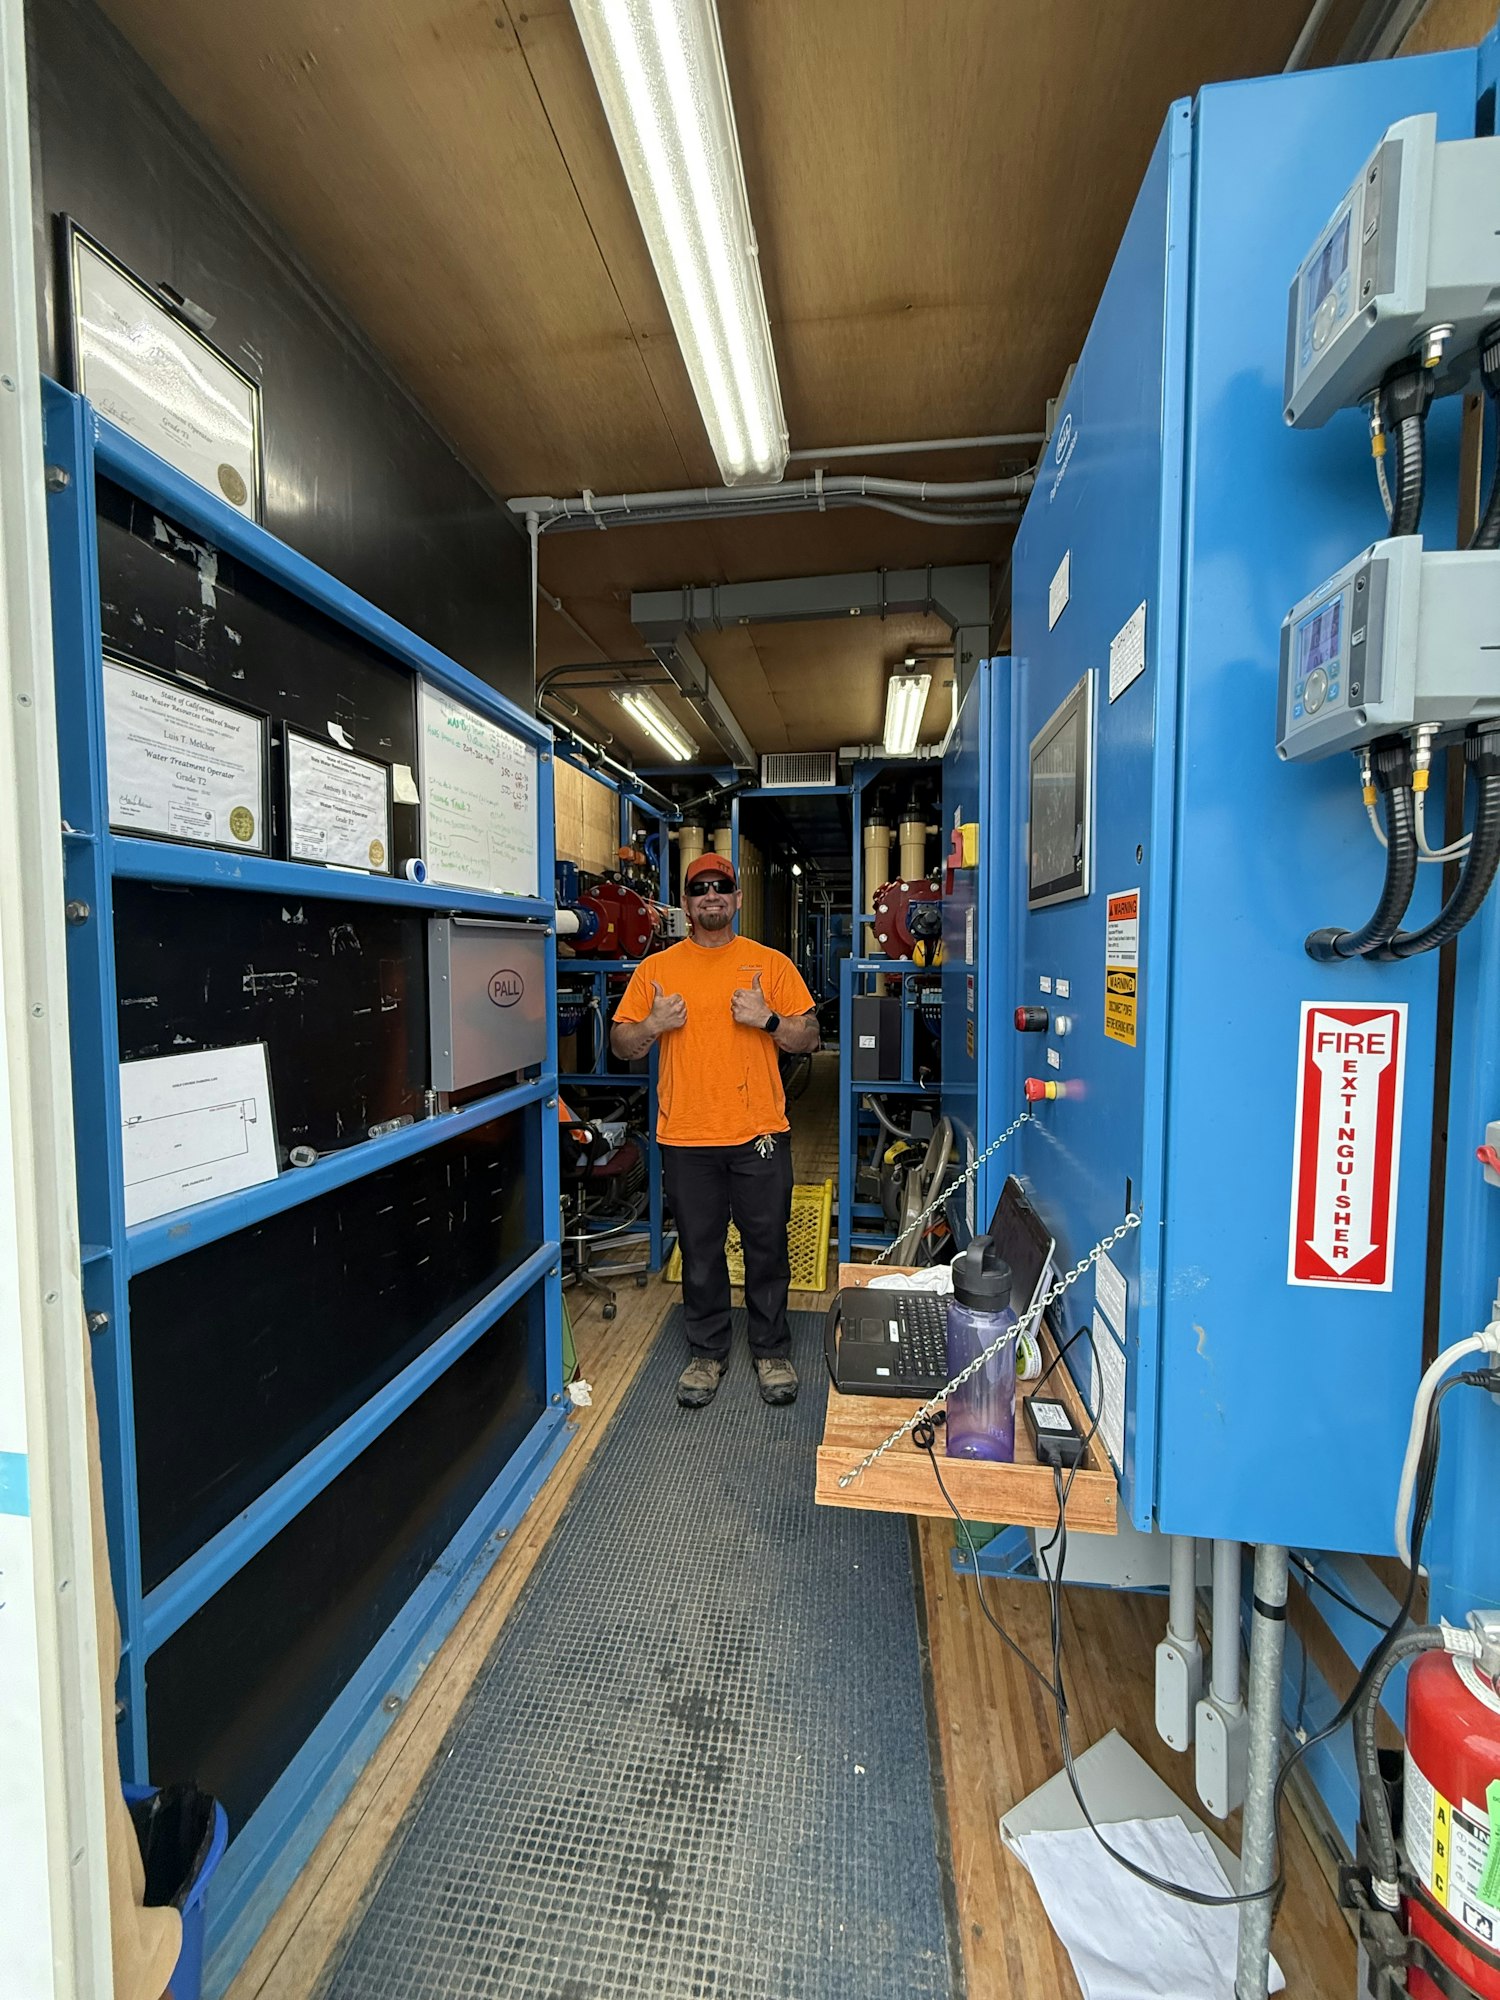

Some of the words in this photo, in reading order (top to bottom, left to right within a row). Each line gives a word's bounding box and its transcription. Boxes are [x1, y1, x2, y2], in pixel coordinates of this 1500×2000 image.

[130, 690, 149, 702] State
[150, 695, 170, 708] Water
[172, 704, 200, 720] Resources
[201, 714, 224, 727] Control
[224, 722, 240, 732] Board
[161, 690, 177, 702] State
[178, 698, 185, 706] of
[185, 700, 215, 715] California
[163, 730, 179, 742] Luis
[189, 737, 216, 752] Melchor
[144, 748, 168, 762] Water
[169, 756, 206, 772] Treatment
[206, 766, 236, 780] Operator
[175, 771, 196, 784] Grade
[196, 776, 207, 786] T2
[1114, 900, 1137, 916] WARNING
[494, 980, 520, 998] PALL
[1110, 976, 1133, 991] WARNING
[1317, 1032, 1386, 1055] FIRE
[1332, 1060, 1359, 1260] EXTINGUISHER
[1438, 1806, 1446, 1826] A
[1437, 1838, 1444, 1858] B
[1436, 1873, 1444, 1892] C
